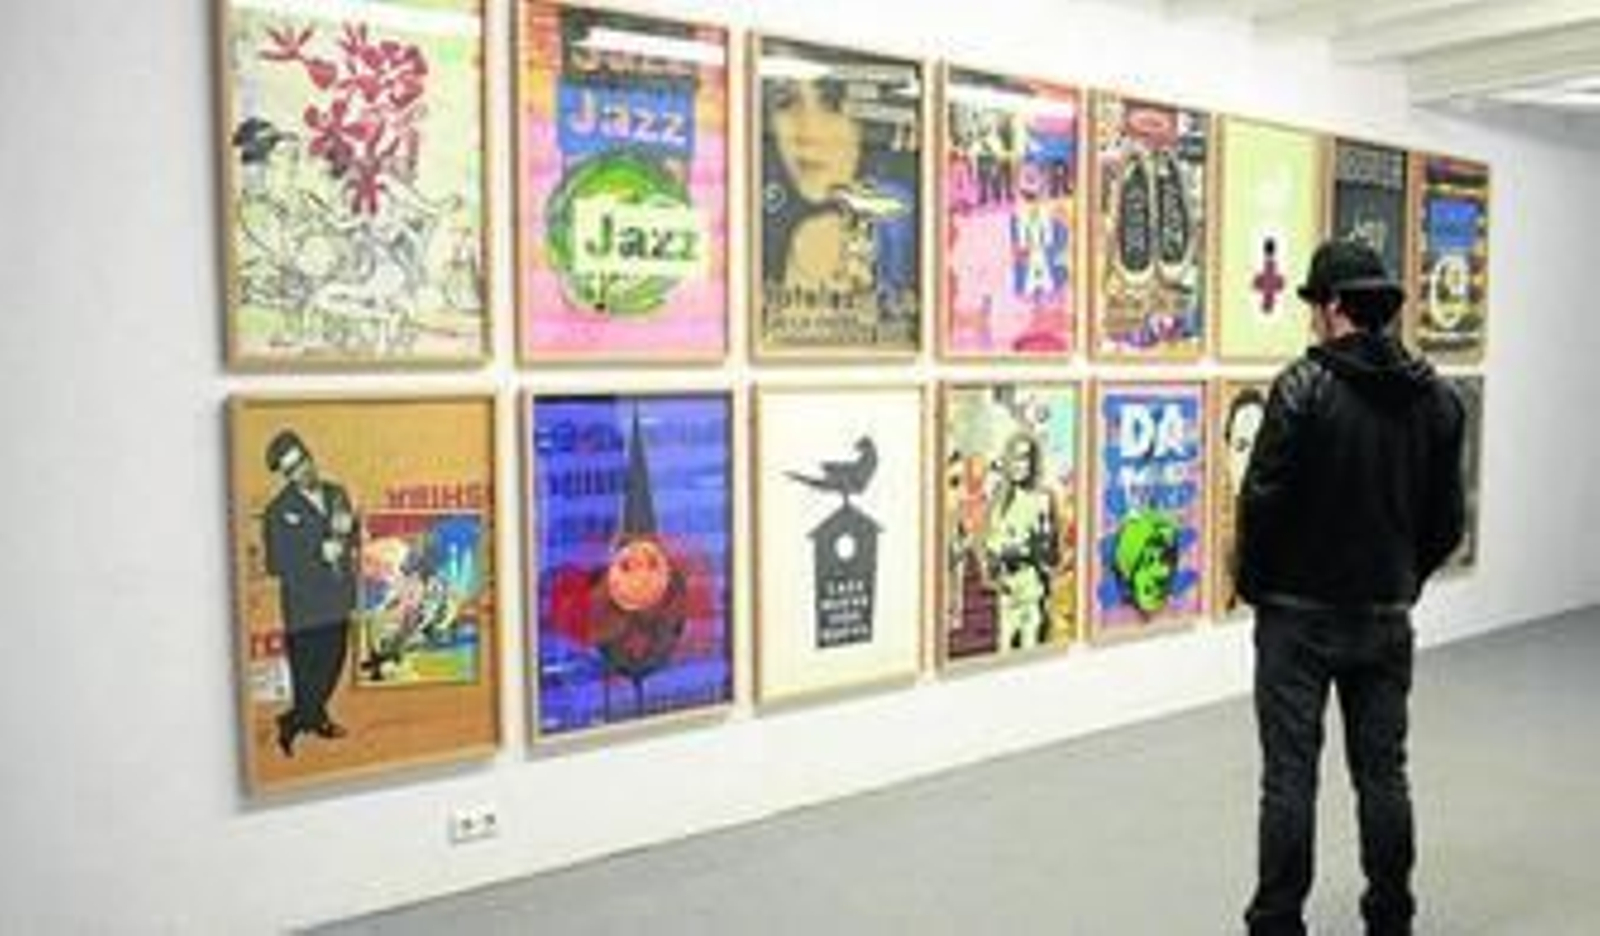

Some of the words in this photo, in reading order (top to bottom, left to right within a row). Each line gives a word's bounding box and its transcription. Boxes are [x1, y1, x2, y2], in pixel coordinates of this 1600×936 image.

[571, 89, 687, 146] Jazz
[585, 214, 700, 261] Jazz
[1120, 403, 1188, 458] DA
